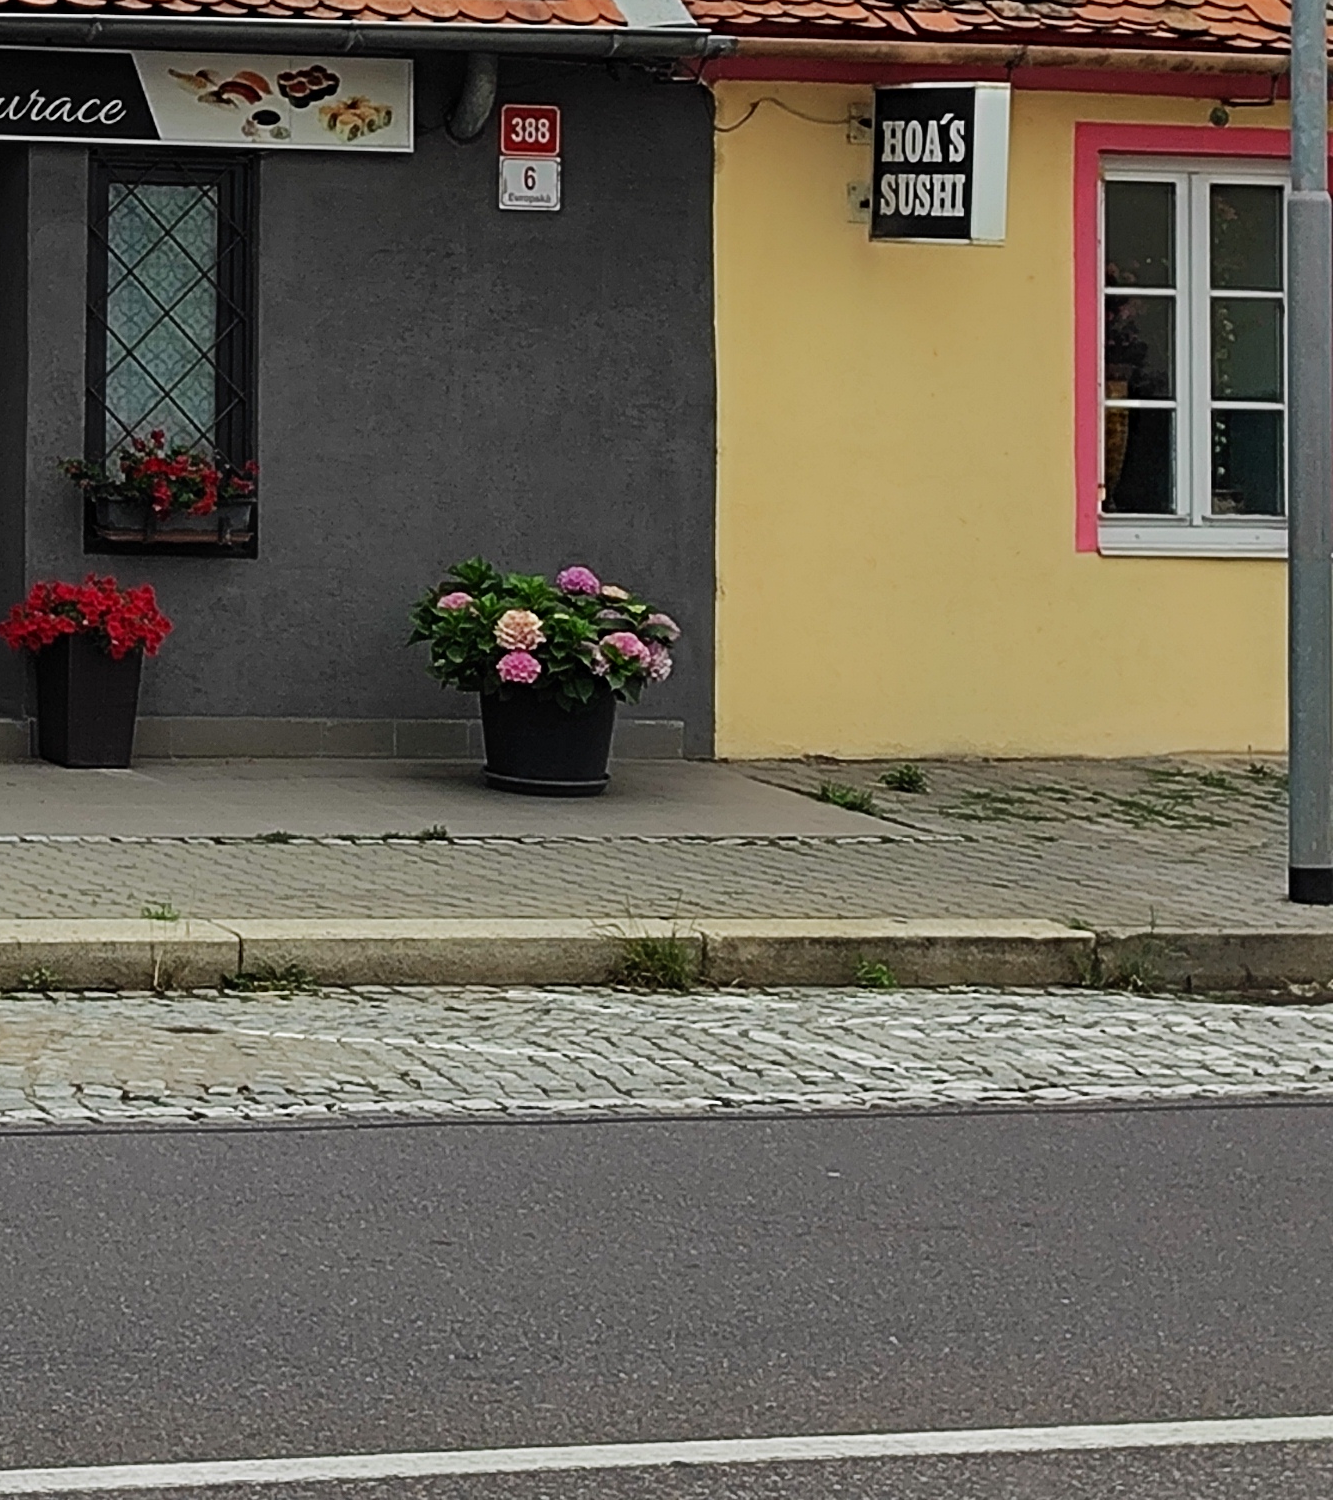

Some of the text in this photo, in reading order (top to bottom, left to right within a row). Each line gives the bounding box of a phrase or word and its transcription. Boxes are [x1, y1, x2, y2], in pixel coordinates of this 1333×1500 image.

[511, 118, 550, 144] 388
[524, 166, 536, 191] 6
[879, 173, 966, 217] SUSHI
